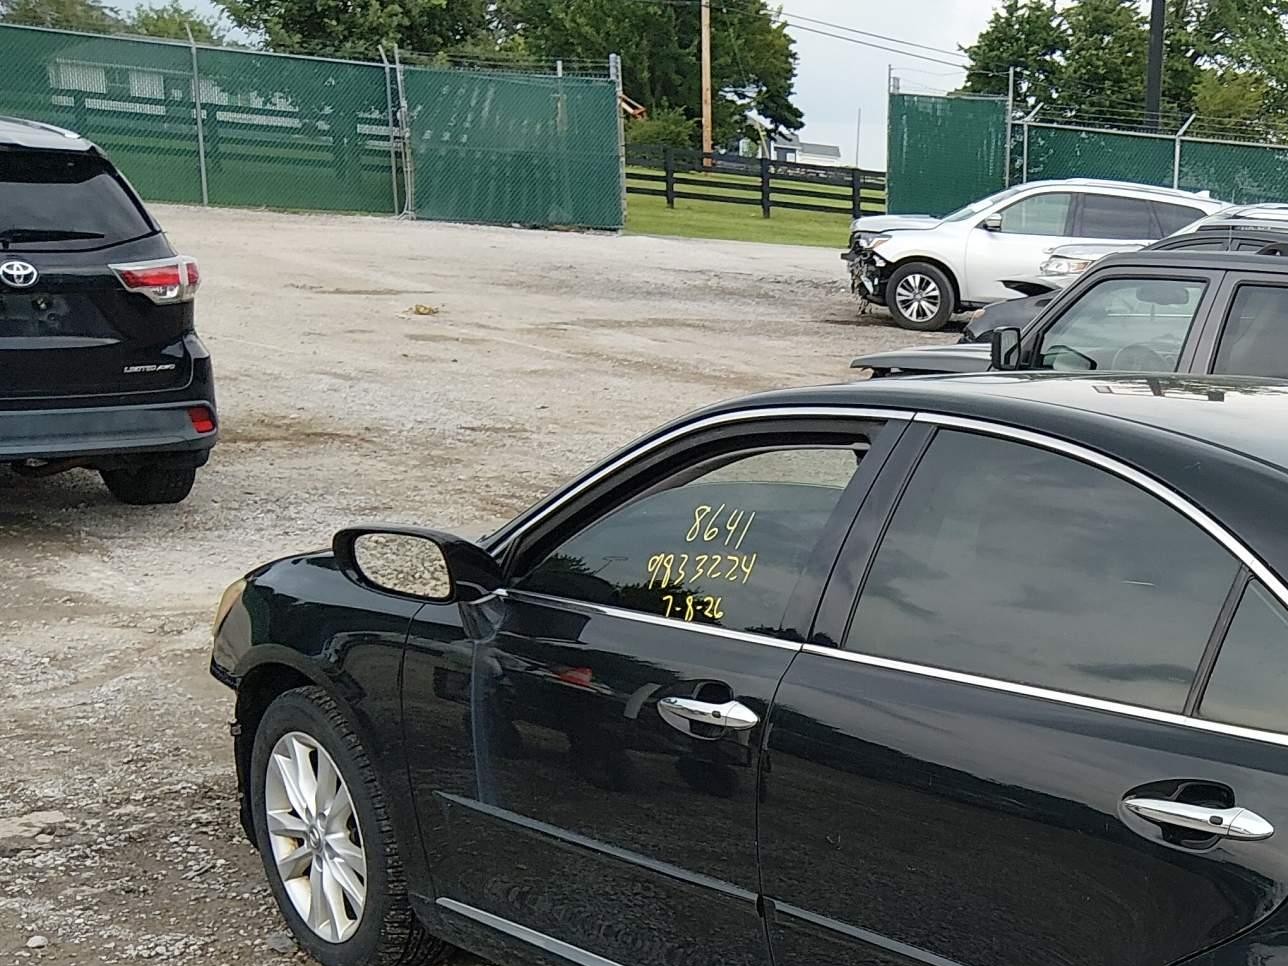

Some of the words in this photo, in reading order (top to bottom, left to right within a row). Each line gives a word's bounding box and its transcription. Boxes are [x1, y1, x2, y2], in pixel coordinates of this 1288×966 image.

[686, 503, 756, 550] 8641
[647, 553, 757, 590] 9833224
[662, 595, 724, 621] 7-8-26
